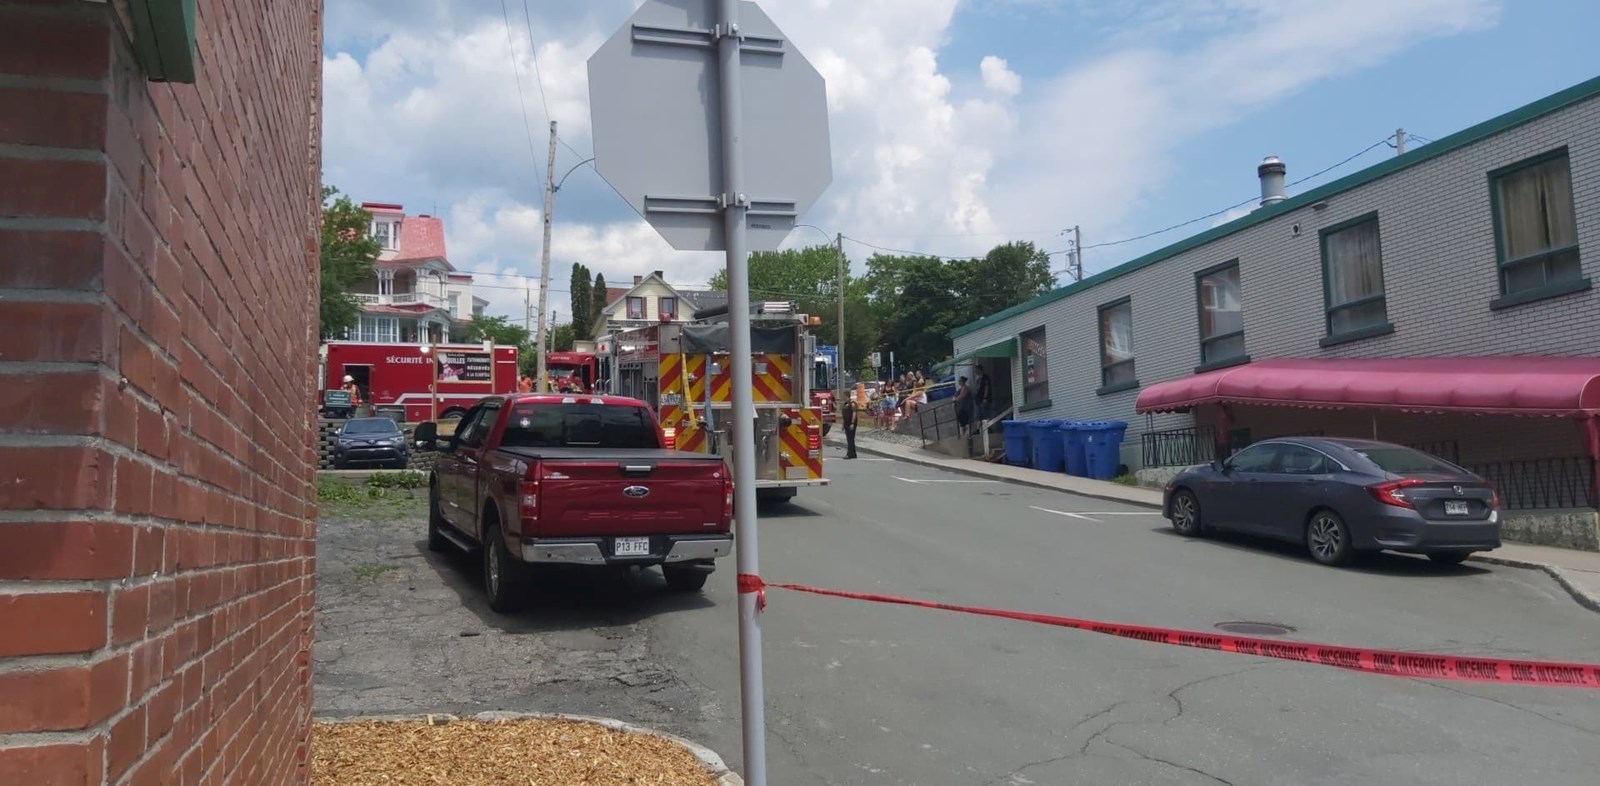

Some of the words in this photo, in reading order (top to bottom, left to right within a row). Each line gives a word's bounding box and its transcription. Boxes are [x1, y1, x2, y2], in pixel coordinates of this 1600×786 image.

[386, 355, 423, 364] SÉCURITÉ
[616, 542, 631, 552] P13
[634, 541, 648, 552] FFC
[1317, 649, 1361, 668] INCENDIE
[1372, 653, 1396, 671] ZONE
[1398, 655, 1448, 676] INTERDITE
[1455, 660, 1501, 679] INCENDIE
[1509, 664, 1535, 681] ZONE
[1536, 666, 1588, 684] INTERDITE
